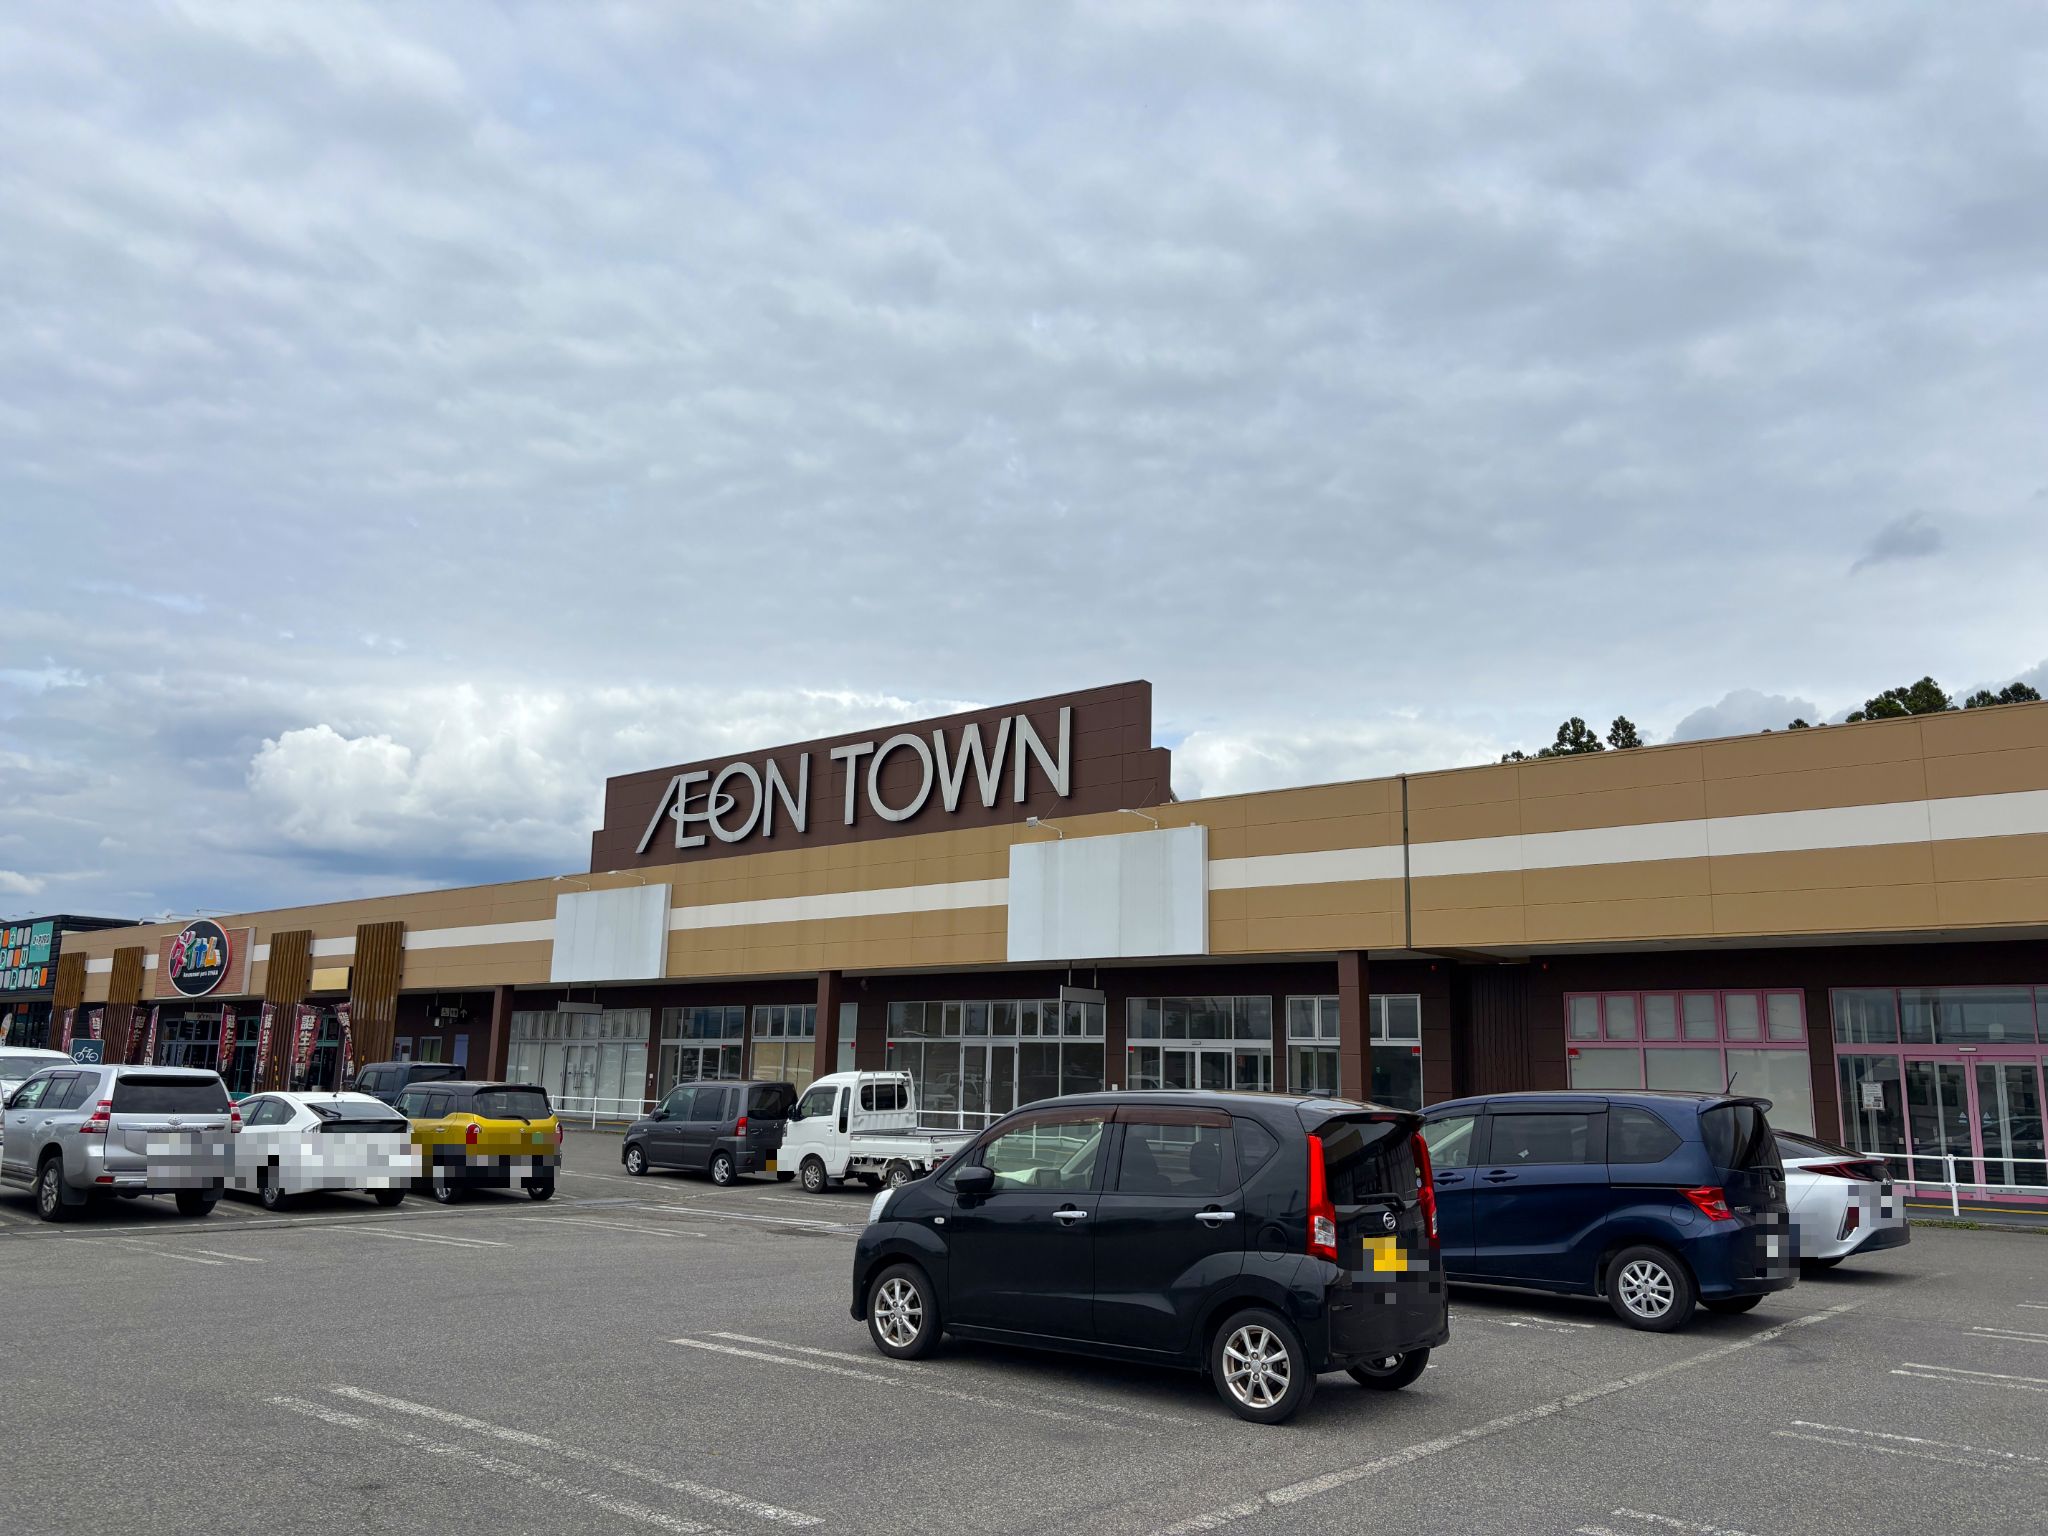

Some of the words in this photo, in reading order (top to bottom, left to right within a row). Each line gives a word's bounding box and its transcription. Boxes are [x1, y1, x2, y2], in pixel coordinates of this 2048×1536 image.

[830, 706, 1071, 825] TOWN
[171, 931, 220, 978] ダイナム
